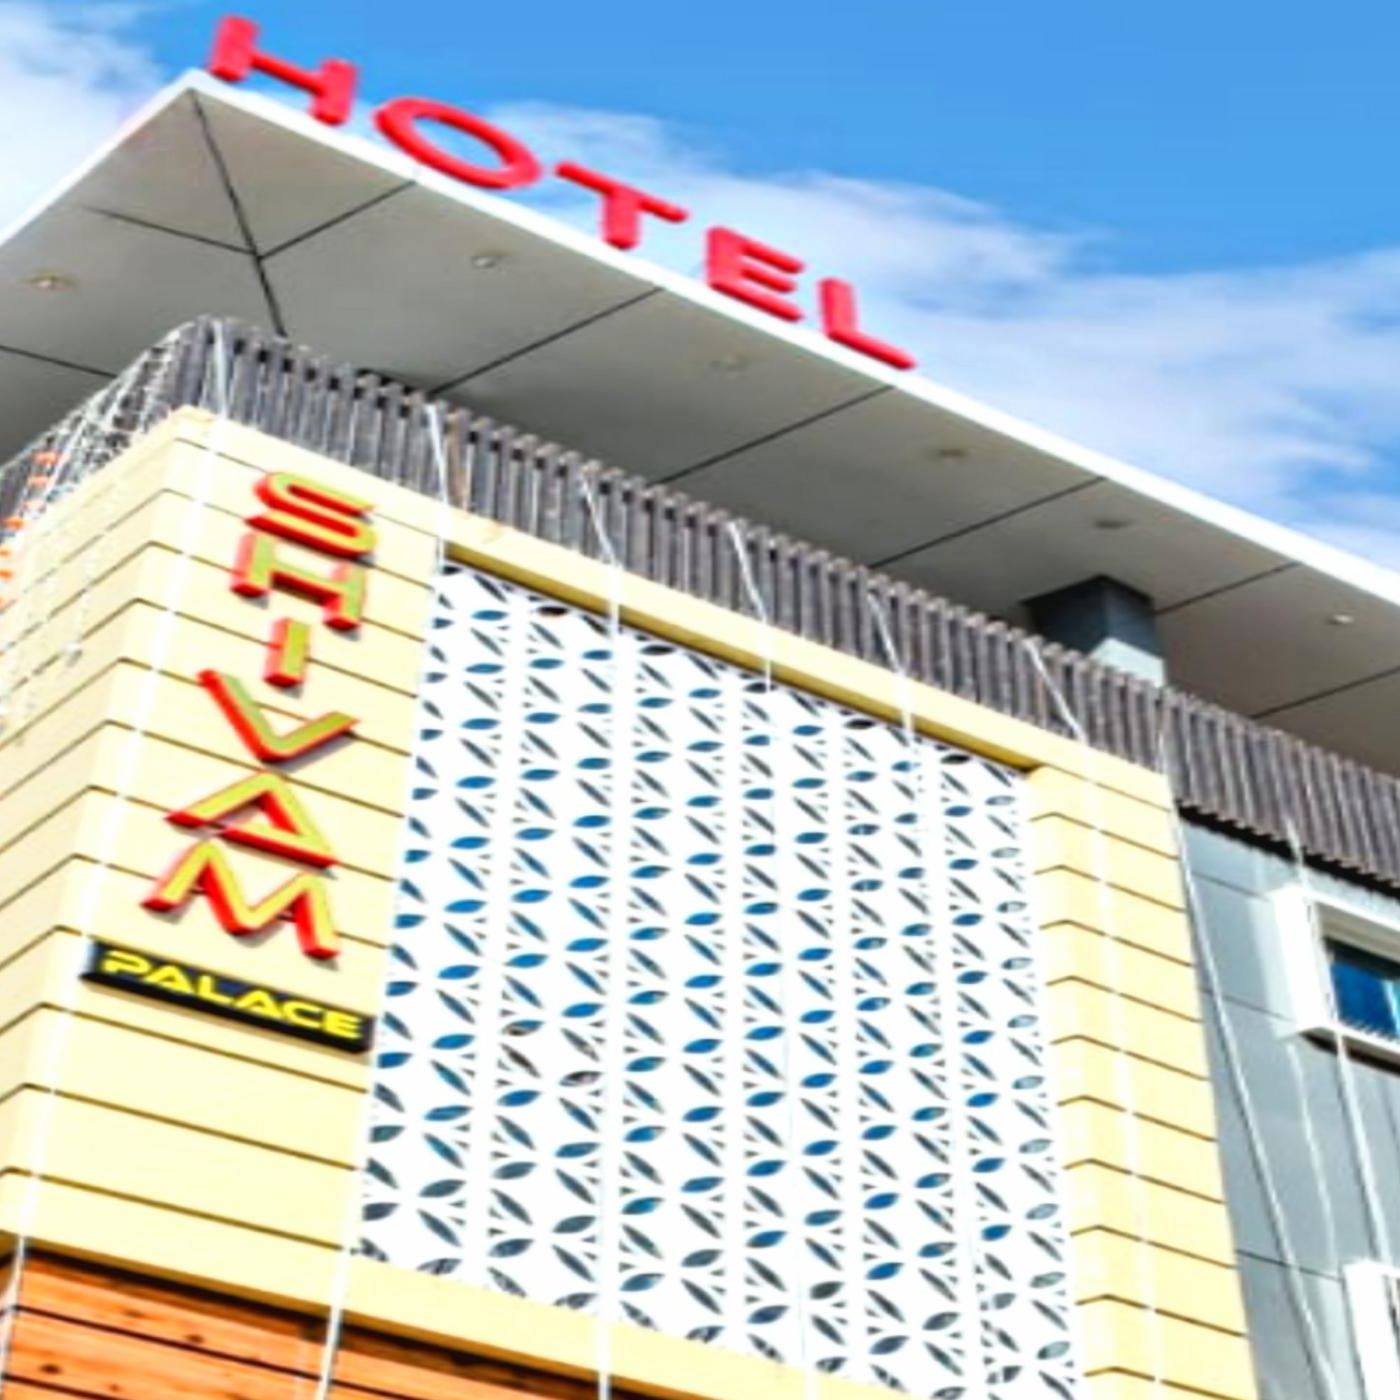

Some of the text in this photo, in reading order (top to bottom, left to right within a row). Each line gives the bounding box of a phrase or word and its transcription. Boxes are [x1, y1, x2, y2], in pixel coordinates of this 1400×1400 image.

[210, 14, 917, 371] HOTEL
[140, 470, 376, 960] SHIVAM
[102, 950, 366, 1042] PALACE
